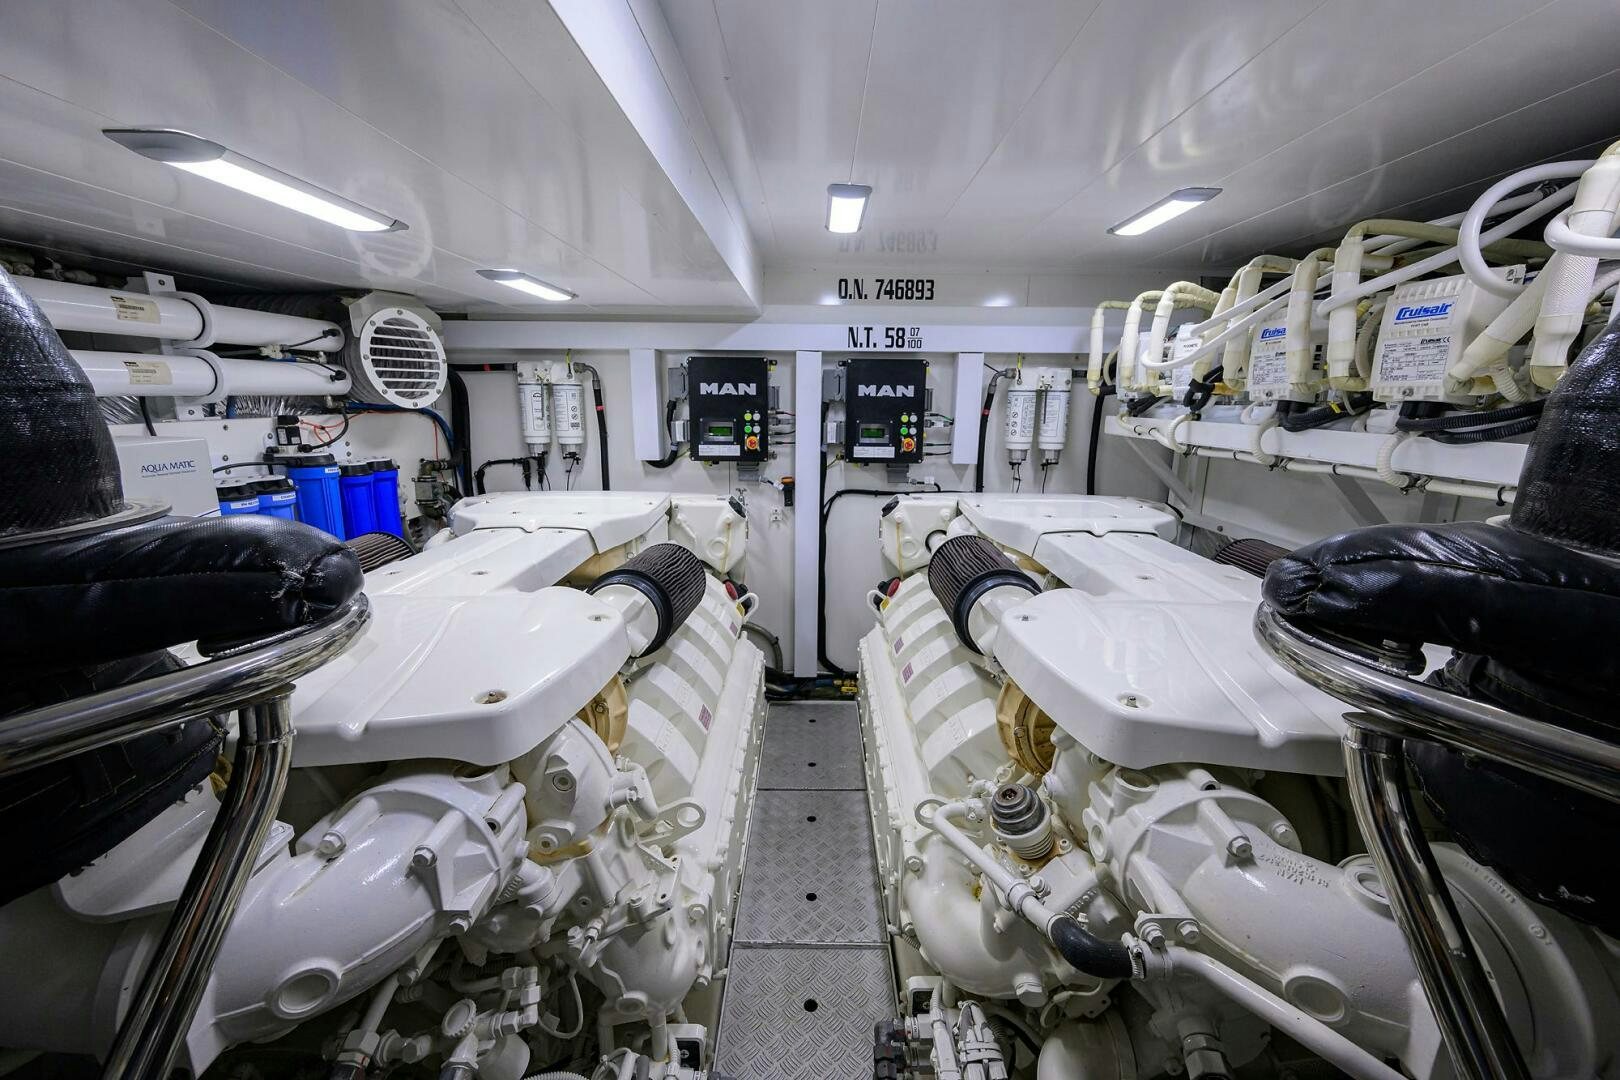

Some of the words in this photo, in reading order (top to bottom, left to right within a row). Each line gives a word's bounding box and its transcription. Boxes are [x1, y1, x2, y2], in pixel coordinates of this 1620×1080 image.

[838, 279, 868, 300] O.N.
[875, 279, 935, 301] 746893
[1395, 302, 1452, 321] Cruisair
[847, 326, 877, 348] N.T.
[884, 327, 906, 349] 58
[910, 327, 921, 337] 07
[1261, 327, 1287, 340] Cruisa
[907, 339, 923, 349] 100
[699, 382, 757, 396] MAN
[857, 384, 915, 398] MAN
[141, 463, 169, 474] AQUA
[169, 460, 196, 470] MATIC
